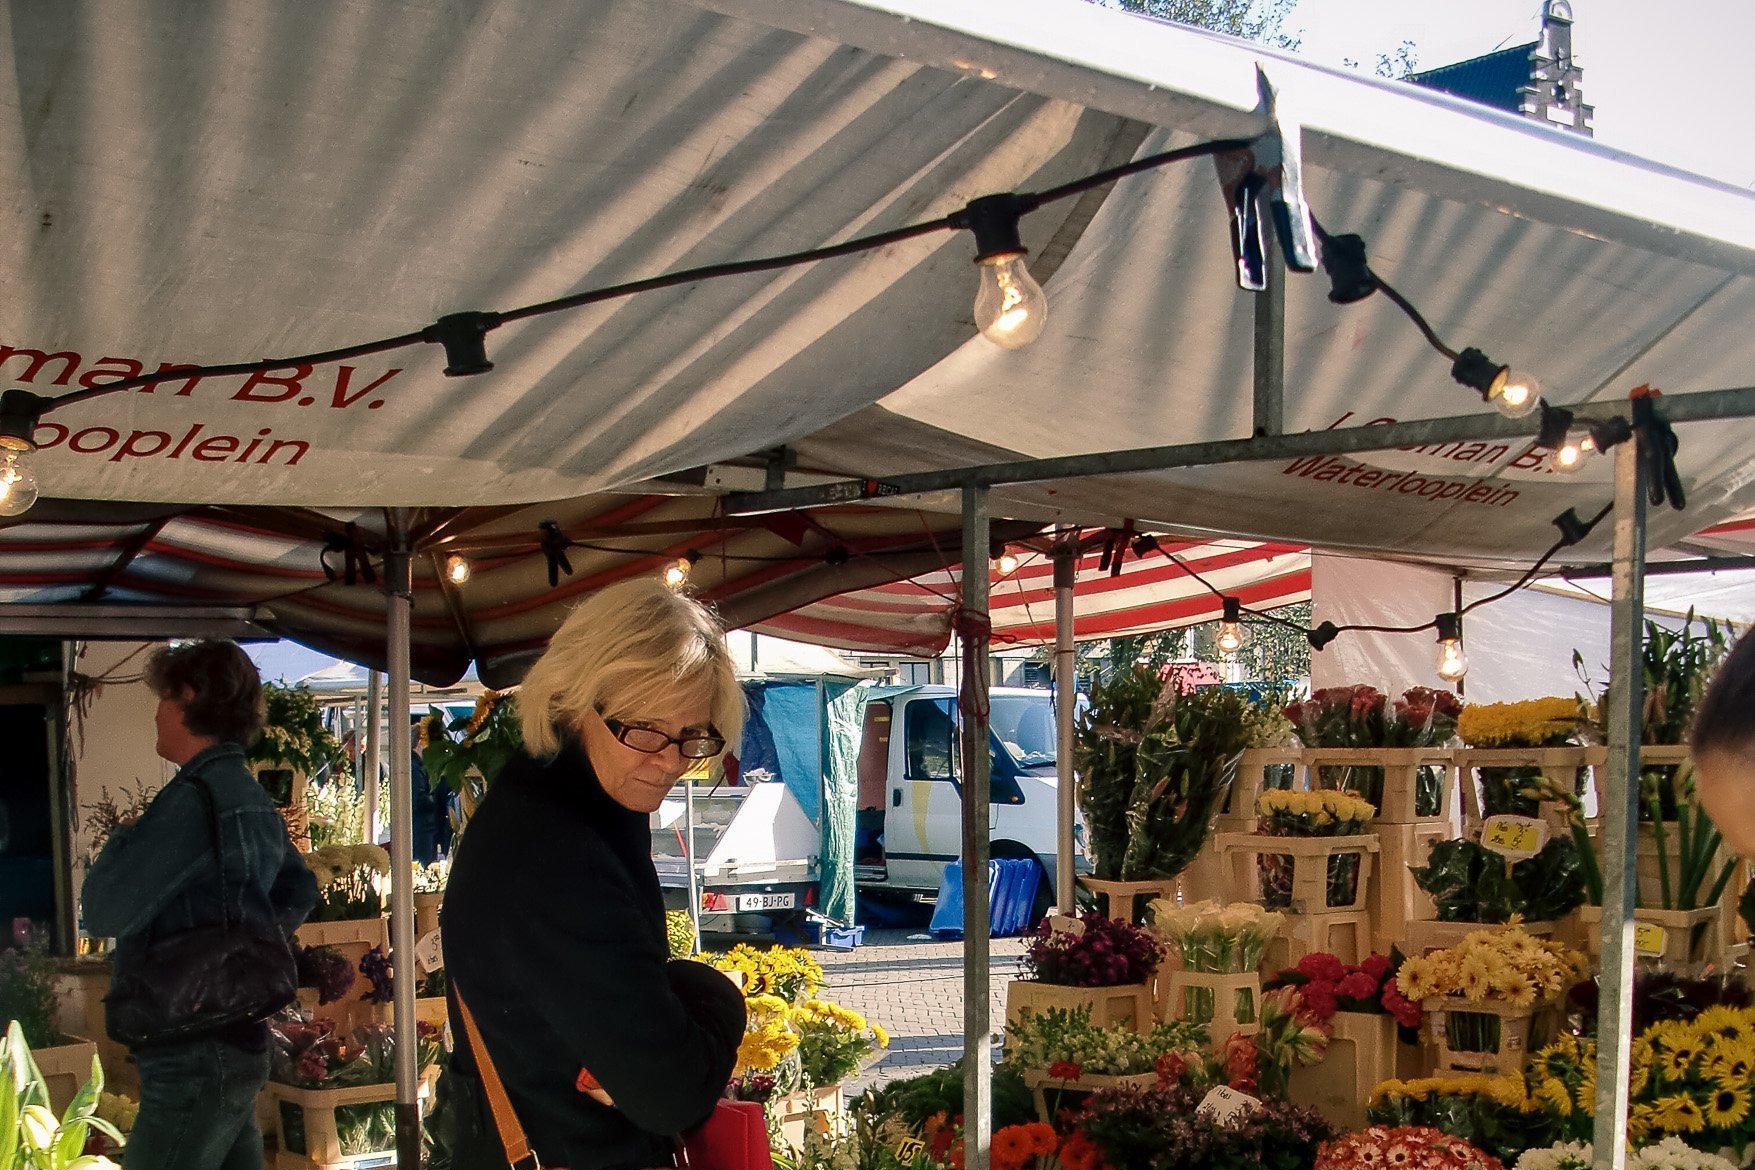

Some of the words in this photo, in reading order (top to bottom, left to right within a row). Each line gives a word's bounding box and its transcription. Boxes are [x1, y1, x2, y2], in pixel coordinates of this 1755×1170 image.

[230, 358, 404, 410] B.V.
[1282, 453, 1521, 507] Waterlooplein
[746, 895, 790, 908] 49-BJ-PG
